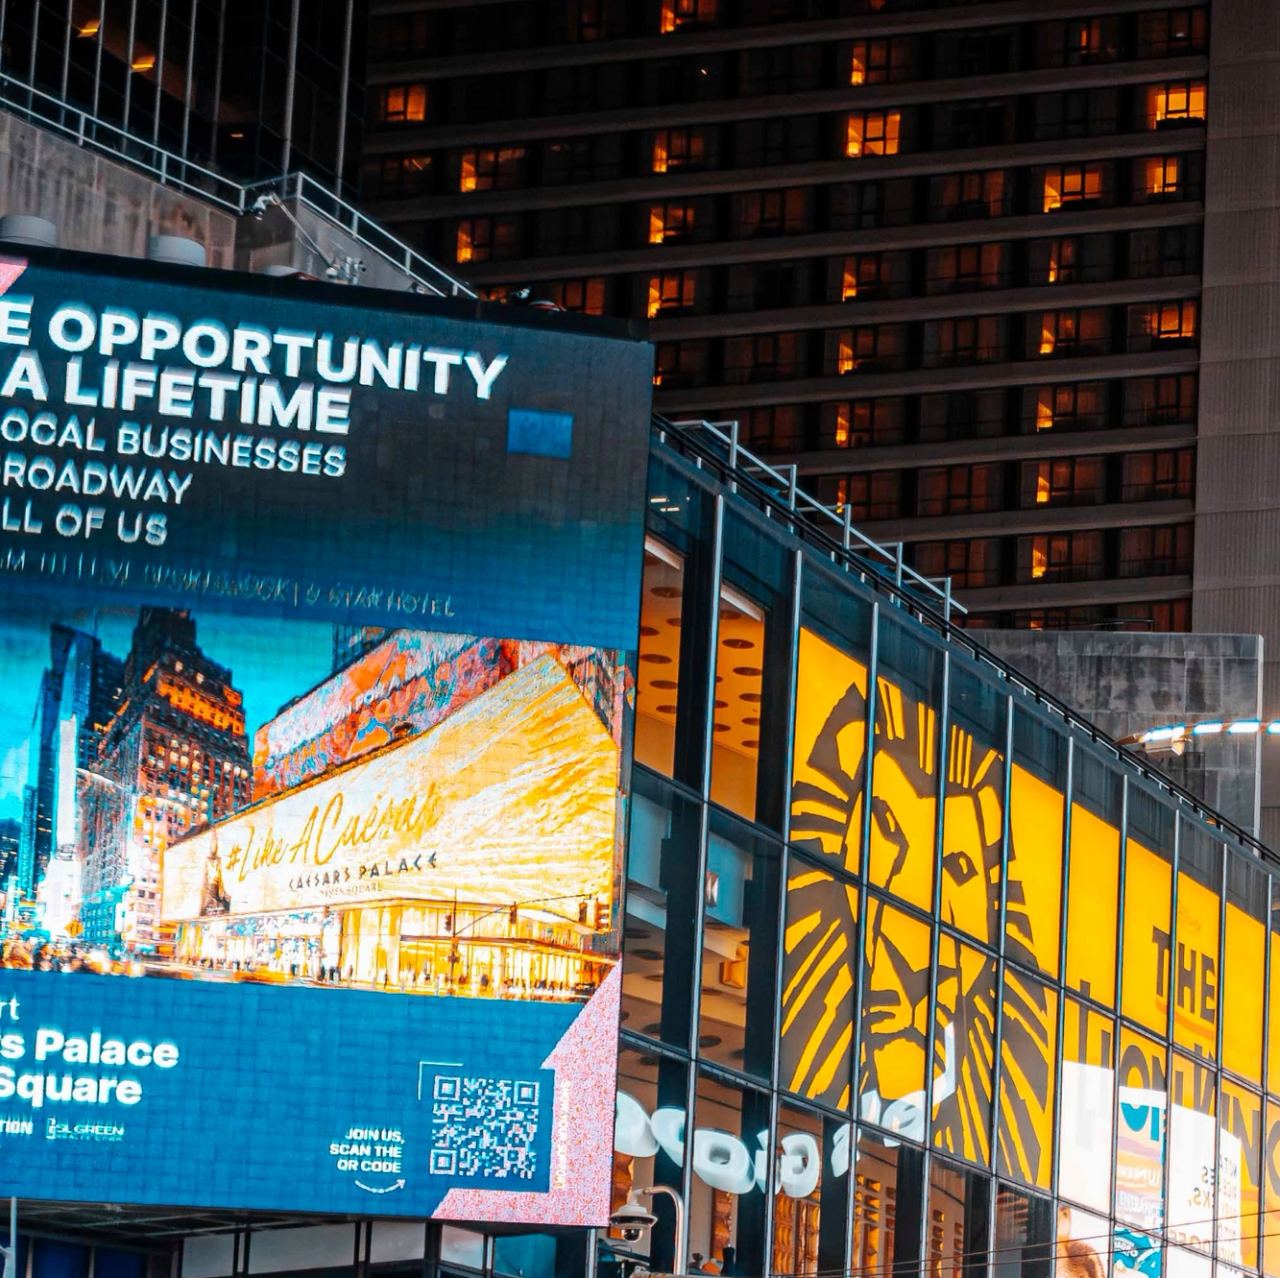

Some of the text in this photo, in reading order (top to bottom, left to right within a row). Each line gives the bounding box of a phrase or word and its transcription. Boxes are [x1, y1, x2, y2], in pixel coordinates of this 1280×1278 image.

[48, 308, 509, 398] OPPORTUNITY
[2, 350, 352, 435] A LIFETIME
[117, 419, 348, 476] BUSINESSES
[55, 505, 105, 539] OF
[118, 512, 168, 546] US
[1152, 925, 1216, 1024] THE
[35, 1028, 179, 1068] Palace
[0, 1065, 142, 1108] Square
[330, 1145, 402, 1158] SCAN THE
[345, 1129, 380, 1140] JOIN
[337, 1160, 401, 1173] QR CODE
